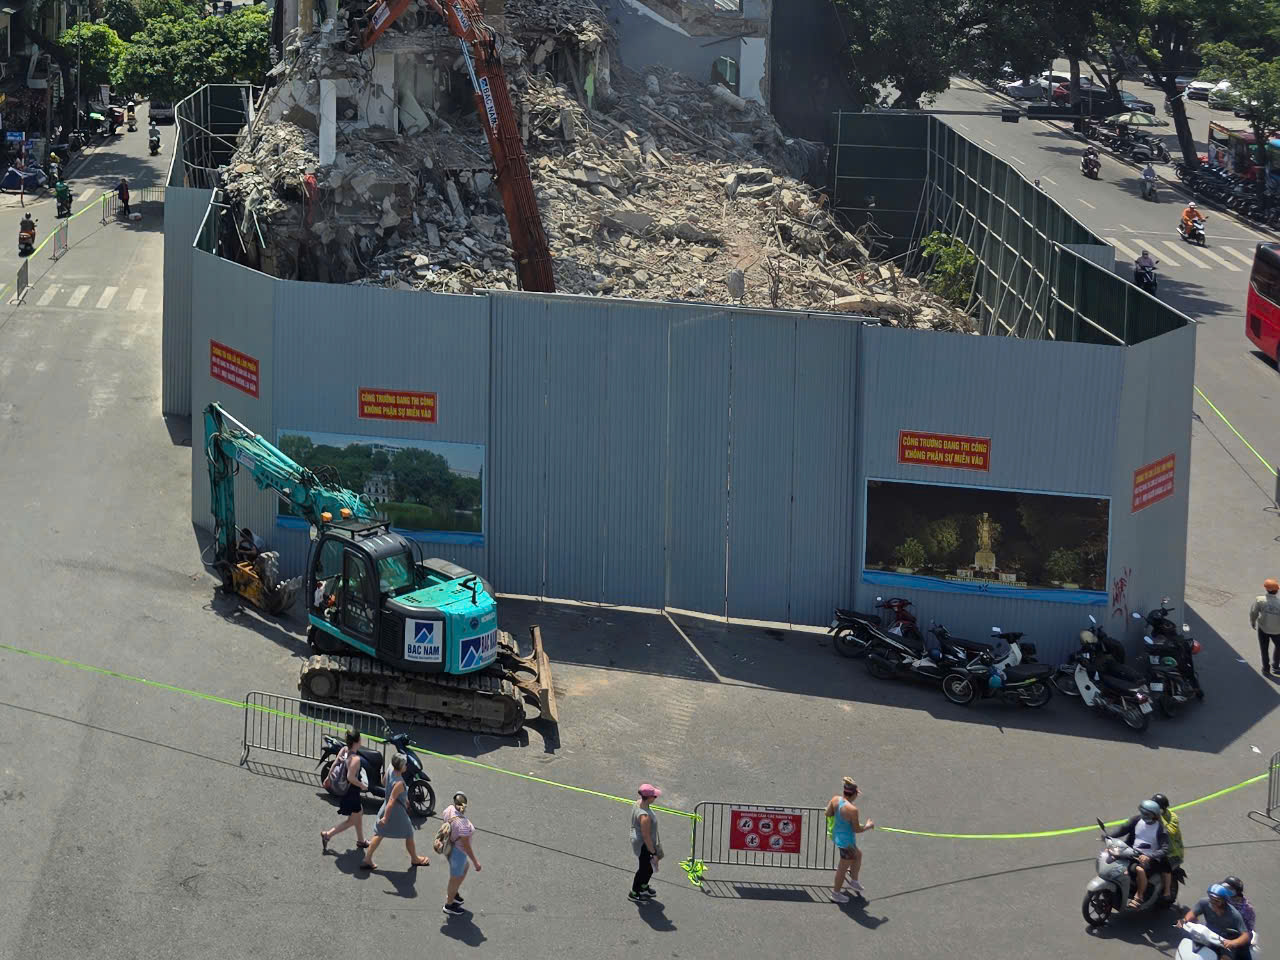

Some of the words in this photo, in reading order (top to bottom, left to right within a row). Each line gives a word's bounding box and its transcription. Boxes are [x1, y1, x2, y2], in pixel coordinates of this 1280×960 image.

[903, 435, 919, 446] CÔNG
[960, 442, 970, 452] THI
[971, 441, 987, 453] CÔNG
[905, 448, 926, 460] KHÔNG
[407, 644, 422, 655] BAC
[423, 645, 440, 656] NAM
